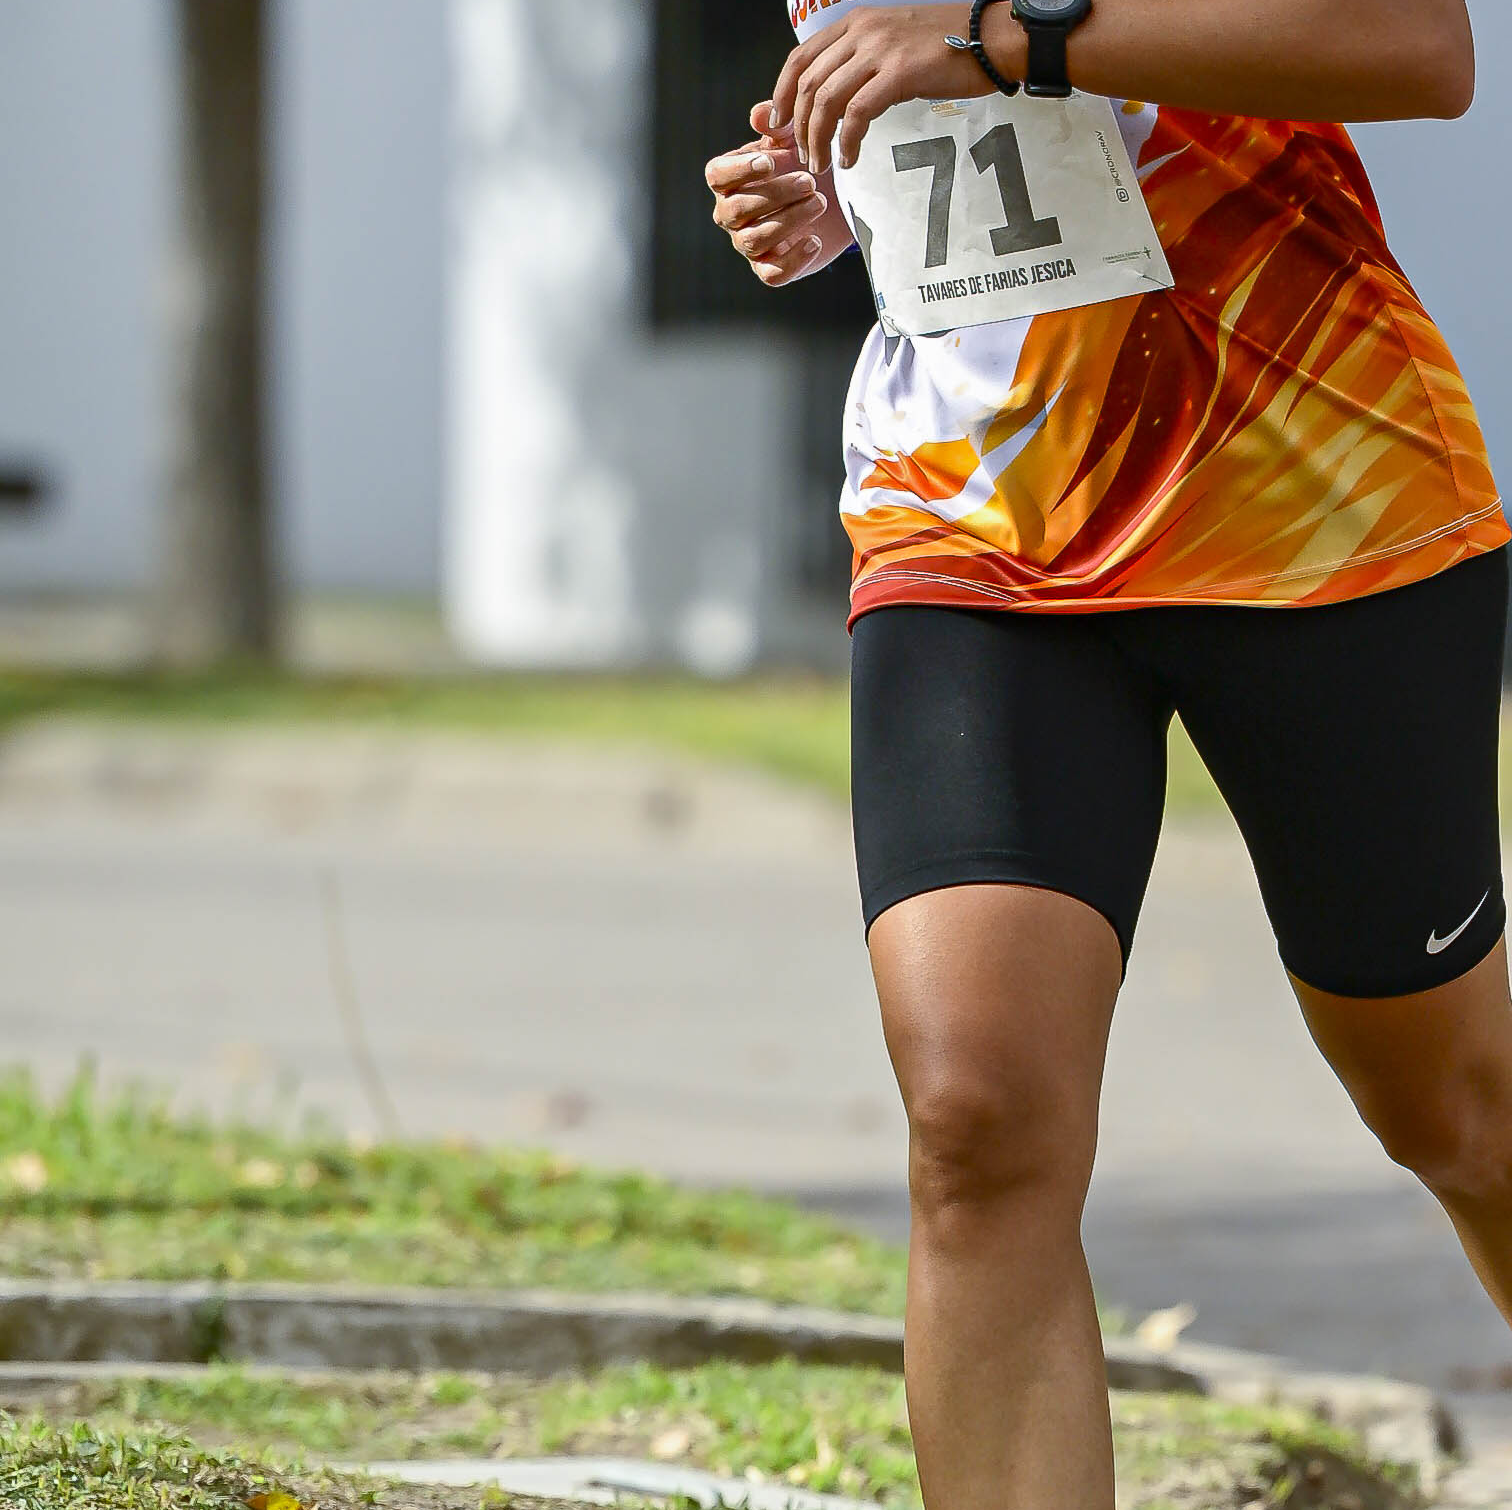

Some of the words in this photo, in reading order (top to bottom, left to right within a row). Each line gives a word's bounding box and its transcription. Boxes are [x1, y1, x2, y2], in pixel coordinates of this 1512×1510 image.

[891, 123, 1063, 268] 71
[918, 278, 968, 304] TAVARES
[968, 275, 985, 295] DE
[984, 267, 1029, 292] FARIAS
[1030, 258, 1077, 284] JESICA
